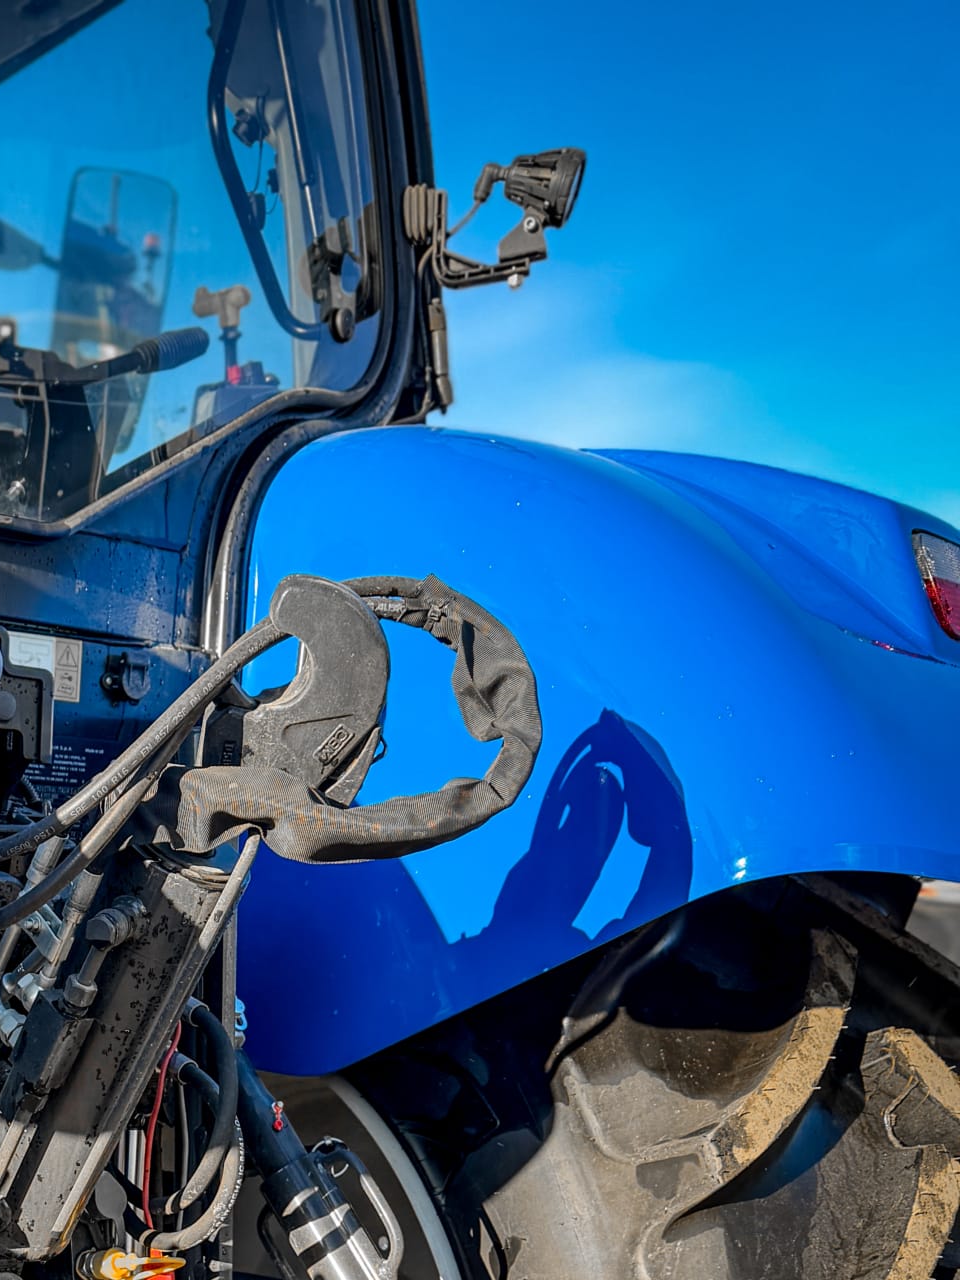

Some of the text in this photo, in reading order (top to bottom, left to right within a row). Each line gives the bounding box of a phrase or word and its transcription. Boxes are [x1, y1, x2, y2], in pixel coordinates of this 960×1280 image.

[91, 784, 109, 801] 100
[139, 743, 152, 758] EN
[34, 826, 56, 842] PSI)
